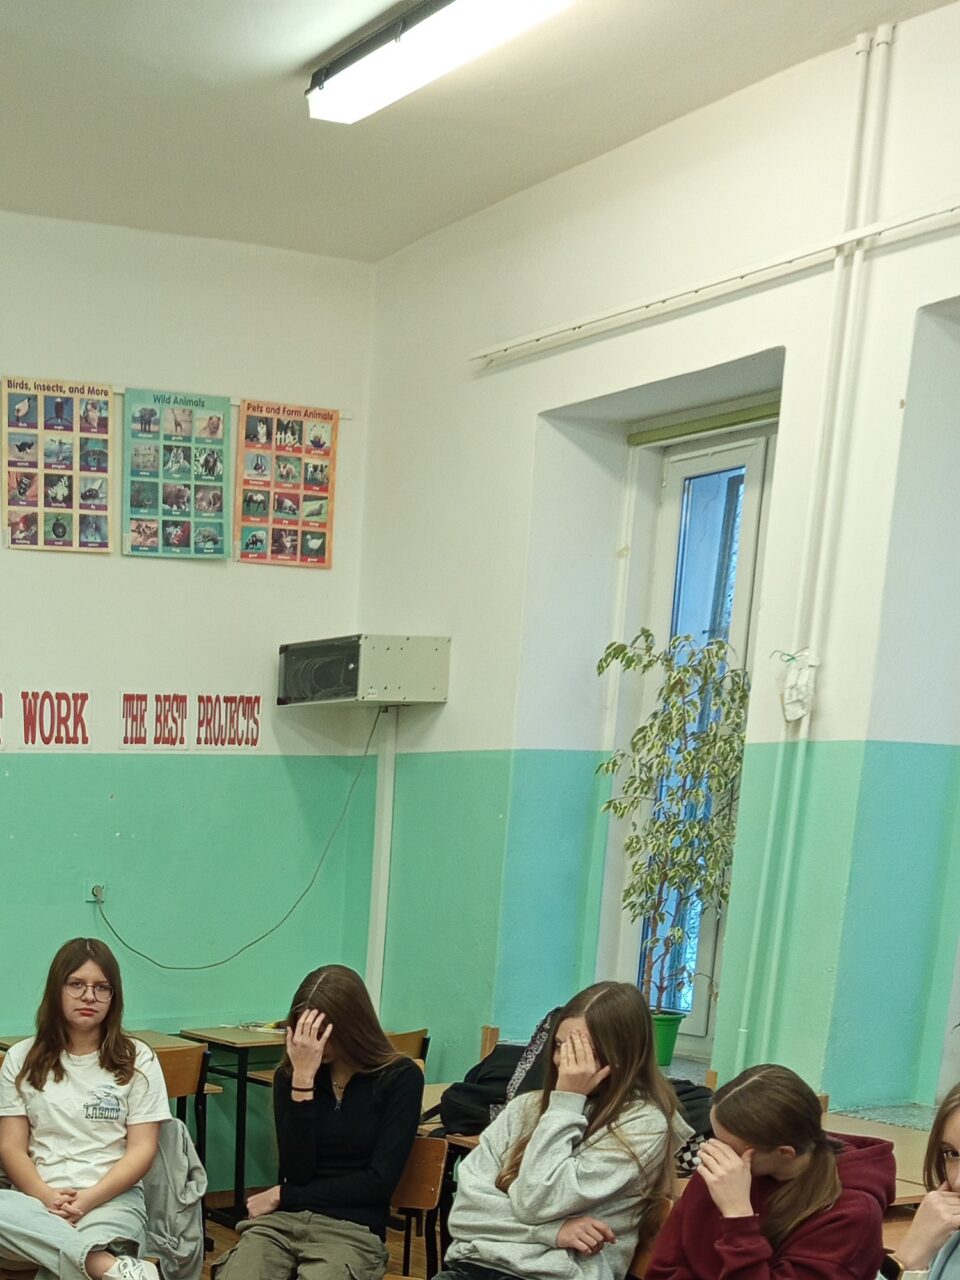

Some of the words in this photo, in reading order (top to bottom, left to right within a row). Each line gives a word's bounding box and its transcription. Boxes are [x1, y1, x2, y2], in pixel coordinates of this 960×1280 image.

[7, 379, 31, 391] Birds,
[33, 382, 66, 394] Insects,
[68, 385, 85, 395] and
[87, 386, 109, 397] More
[153, 394, 171, 404] Wild
[173, 396, 205, 408] Animals
[247, 403, 263, 413] Pets
[265, 405, 281, 415] and
[282, 407, 302, 417] Farm
[303, 409, 334, 421] Animals
[21, 690, 89, 745] WORK
[122, 693, 148, 745] THE
[154, 693, 188, 746] BEST
[196, 694, 261, 747] PROJECTS
